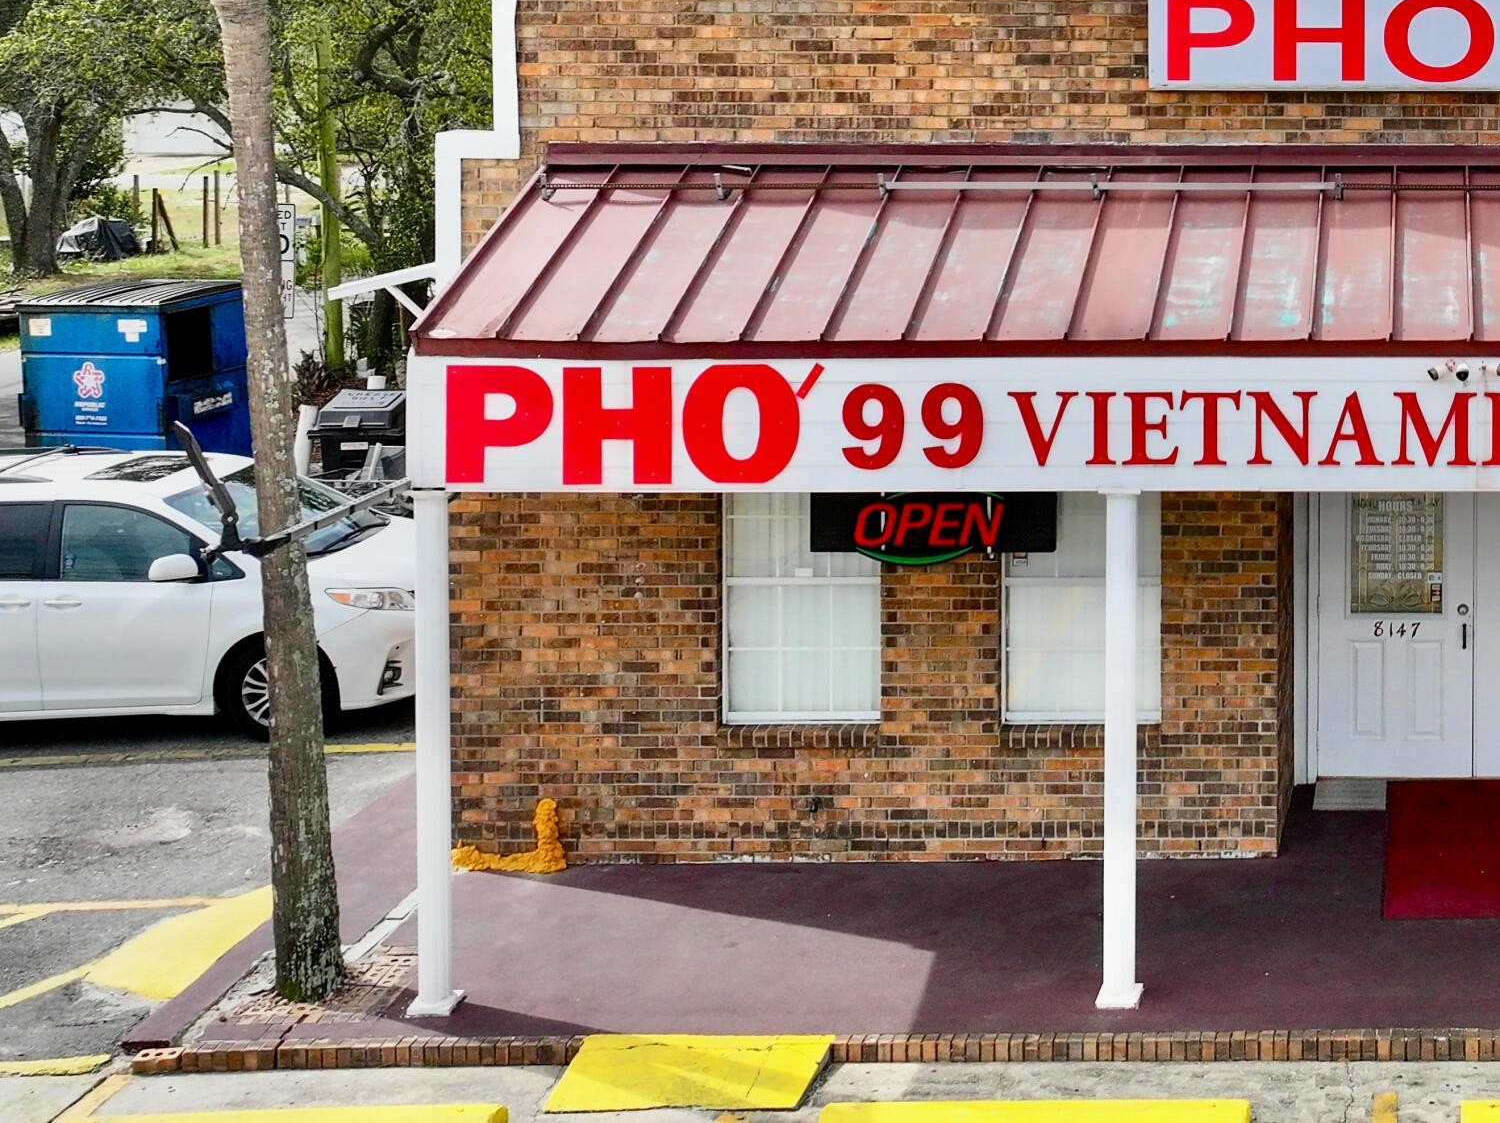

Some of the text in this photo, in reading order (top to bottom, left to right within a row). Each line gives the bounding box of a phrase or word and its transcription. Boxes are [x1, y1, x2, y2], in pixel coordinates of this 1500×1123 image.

[841, 381, 985, 472] 99
[1378, 500, 1413, 512] HOURS
[853, 501, 1005, 548] OPEN
[1373, 620, 1421, 639] 8147
